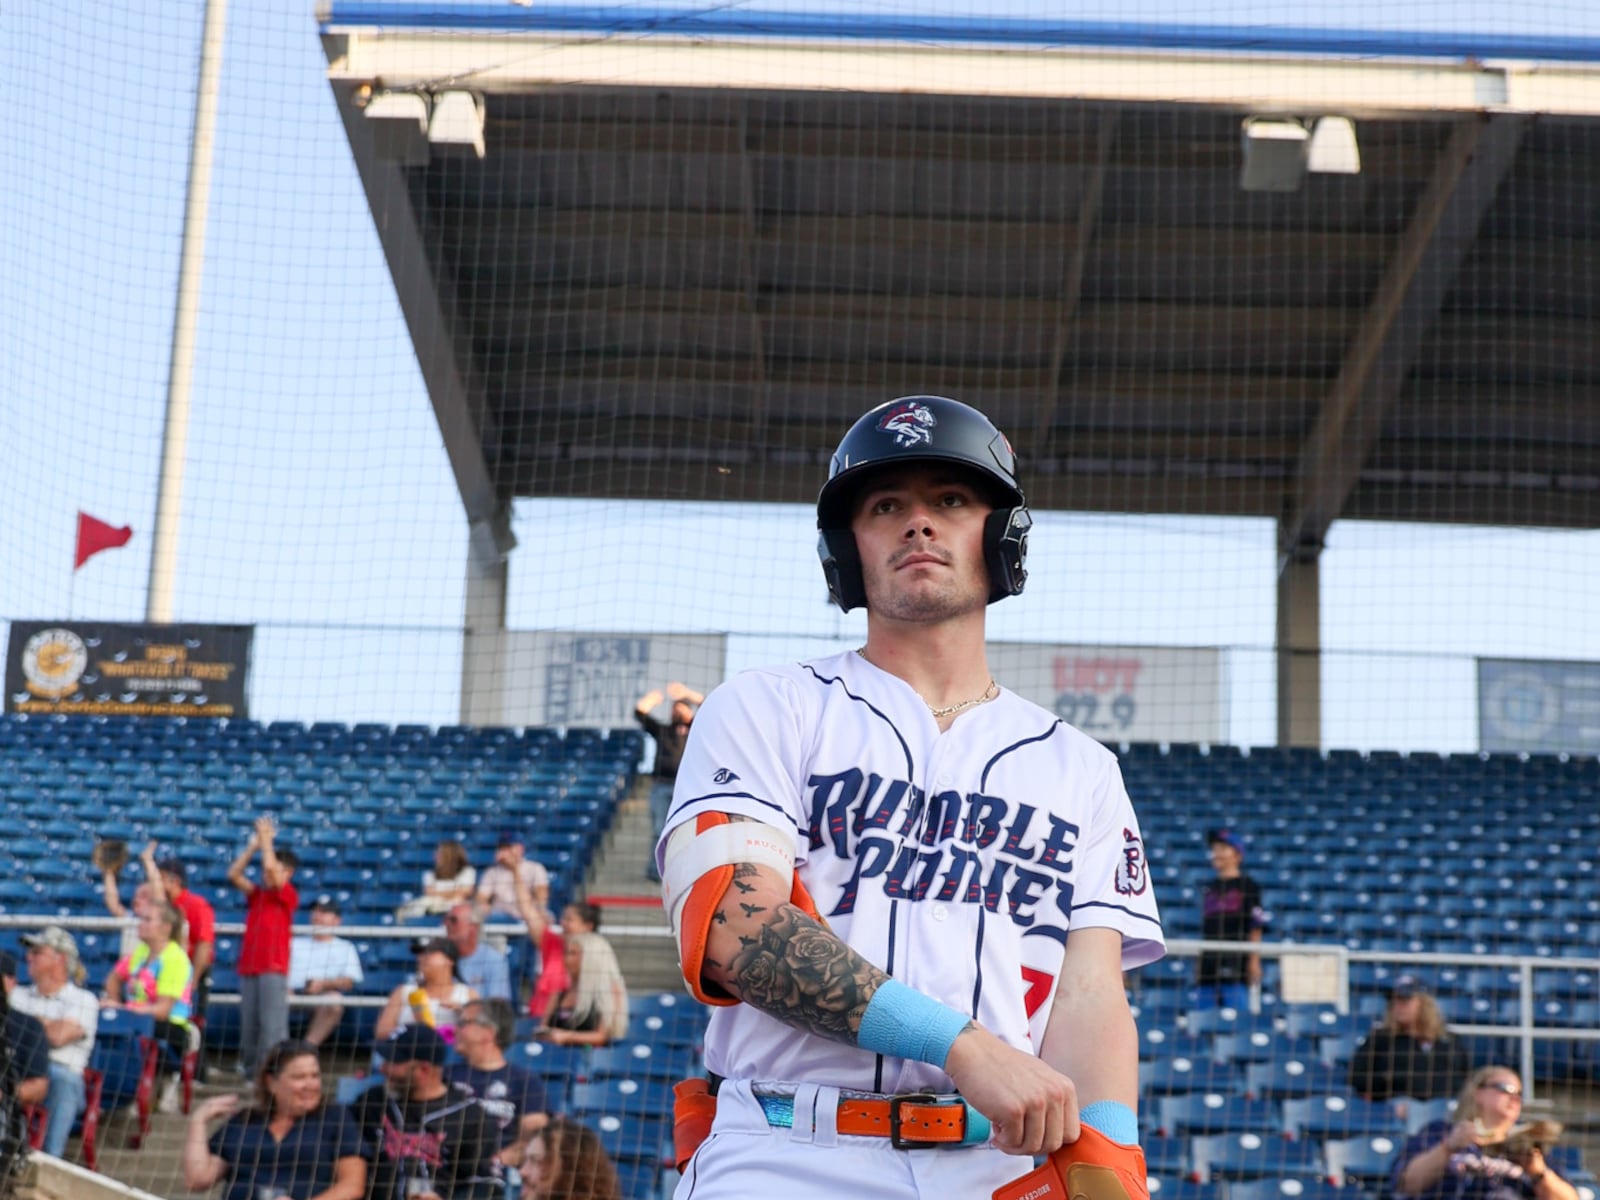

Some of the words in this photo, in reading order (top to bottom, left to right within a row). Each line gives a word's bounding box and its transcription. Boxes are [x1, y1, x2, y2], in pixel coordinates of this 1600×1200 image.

[1053, 656, 1142, 693] HOT
[1054, 692, 1136, 731] 92.9
[808, 766, 1081, 874] RUMBLE
